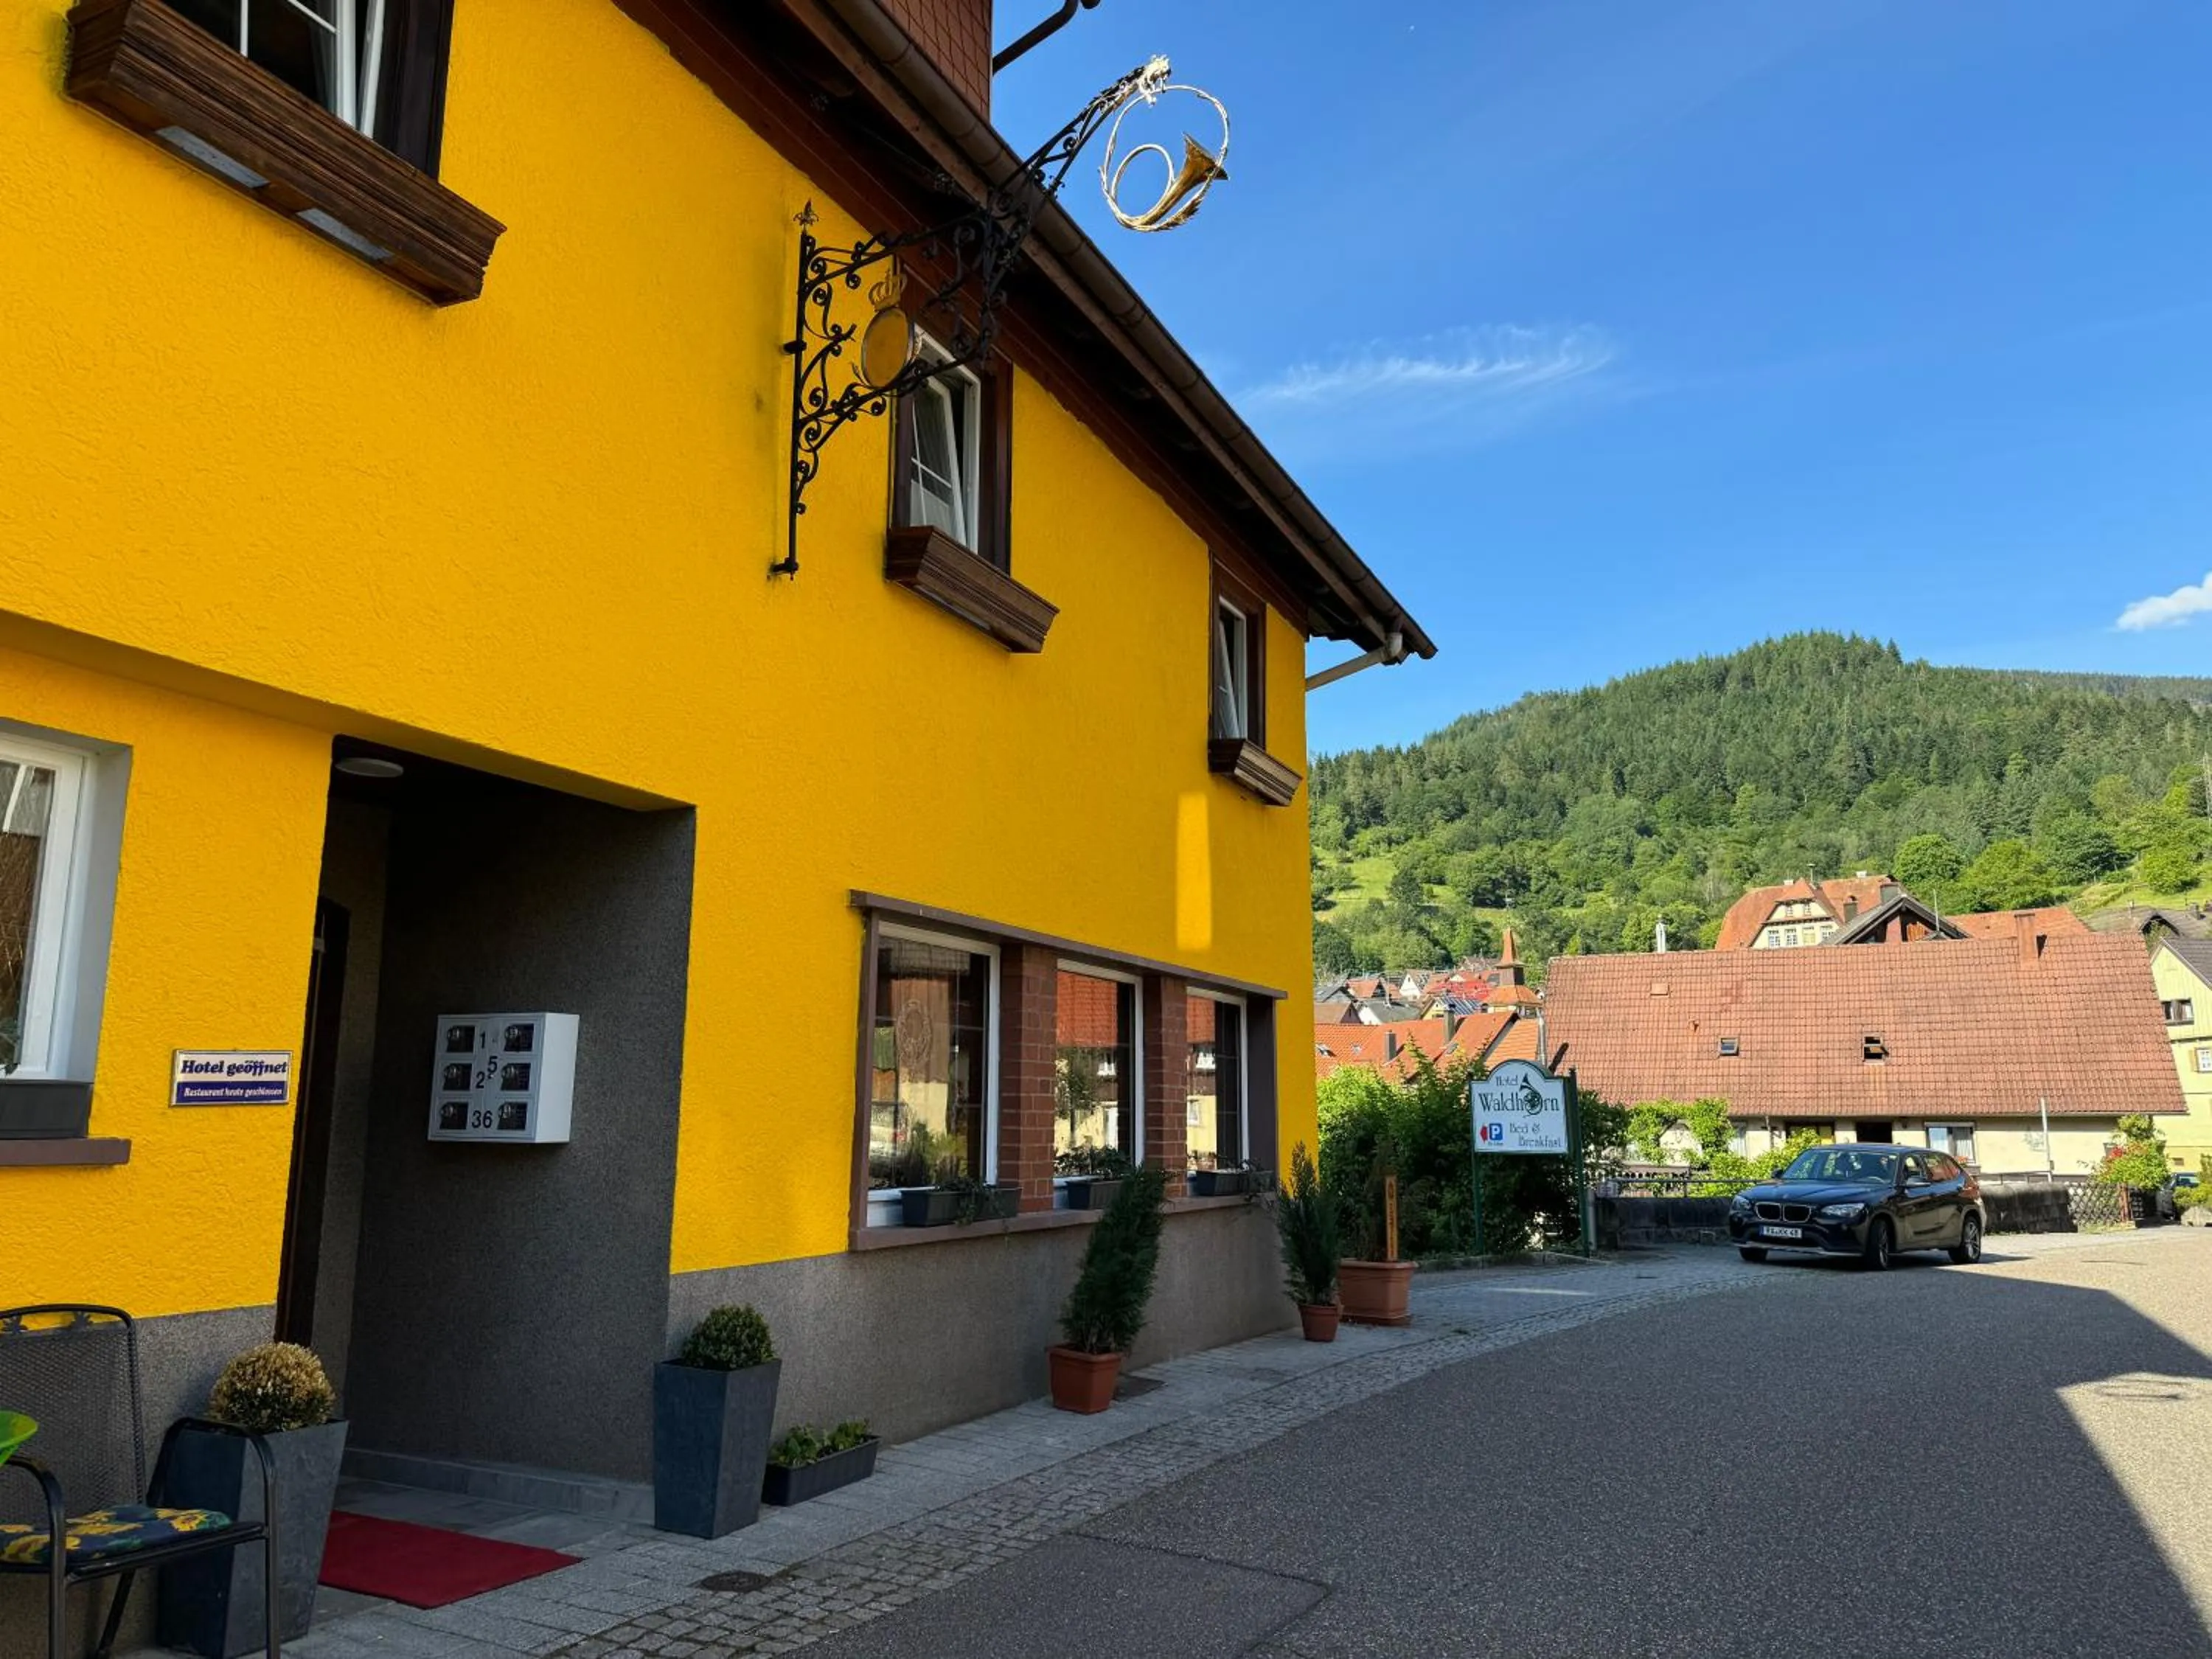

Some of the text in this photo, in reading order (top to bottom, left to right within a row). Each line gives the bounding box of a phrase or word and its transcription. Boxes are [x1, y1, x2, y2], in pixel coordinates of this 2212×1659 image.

[480, 1031, 487, 1049] 1
[181, 1060, 287, 1077] Hotel geöffnet
[487, 1056, 498, 1074] 5
[476, 1071, 485, 1089] 2
[1496, 1075, 1518, 1086] Hotel
[1478, 1092, 1559, 1115] Waldhorn
[1491, 1125, 1500, 1139] P
